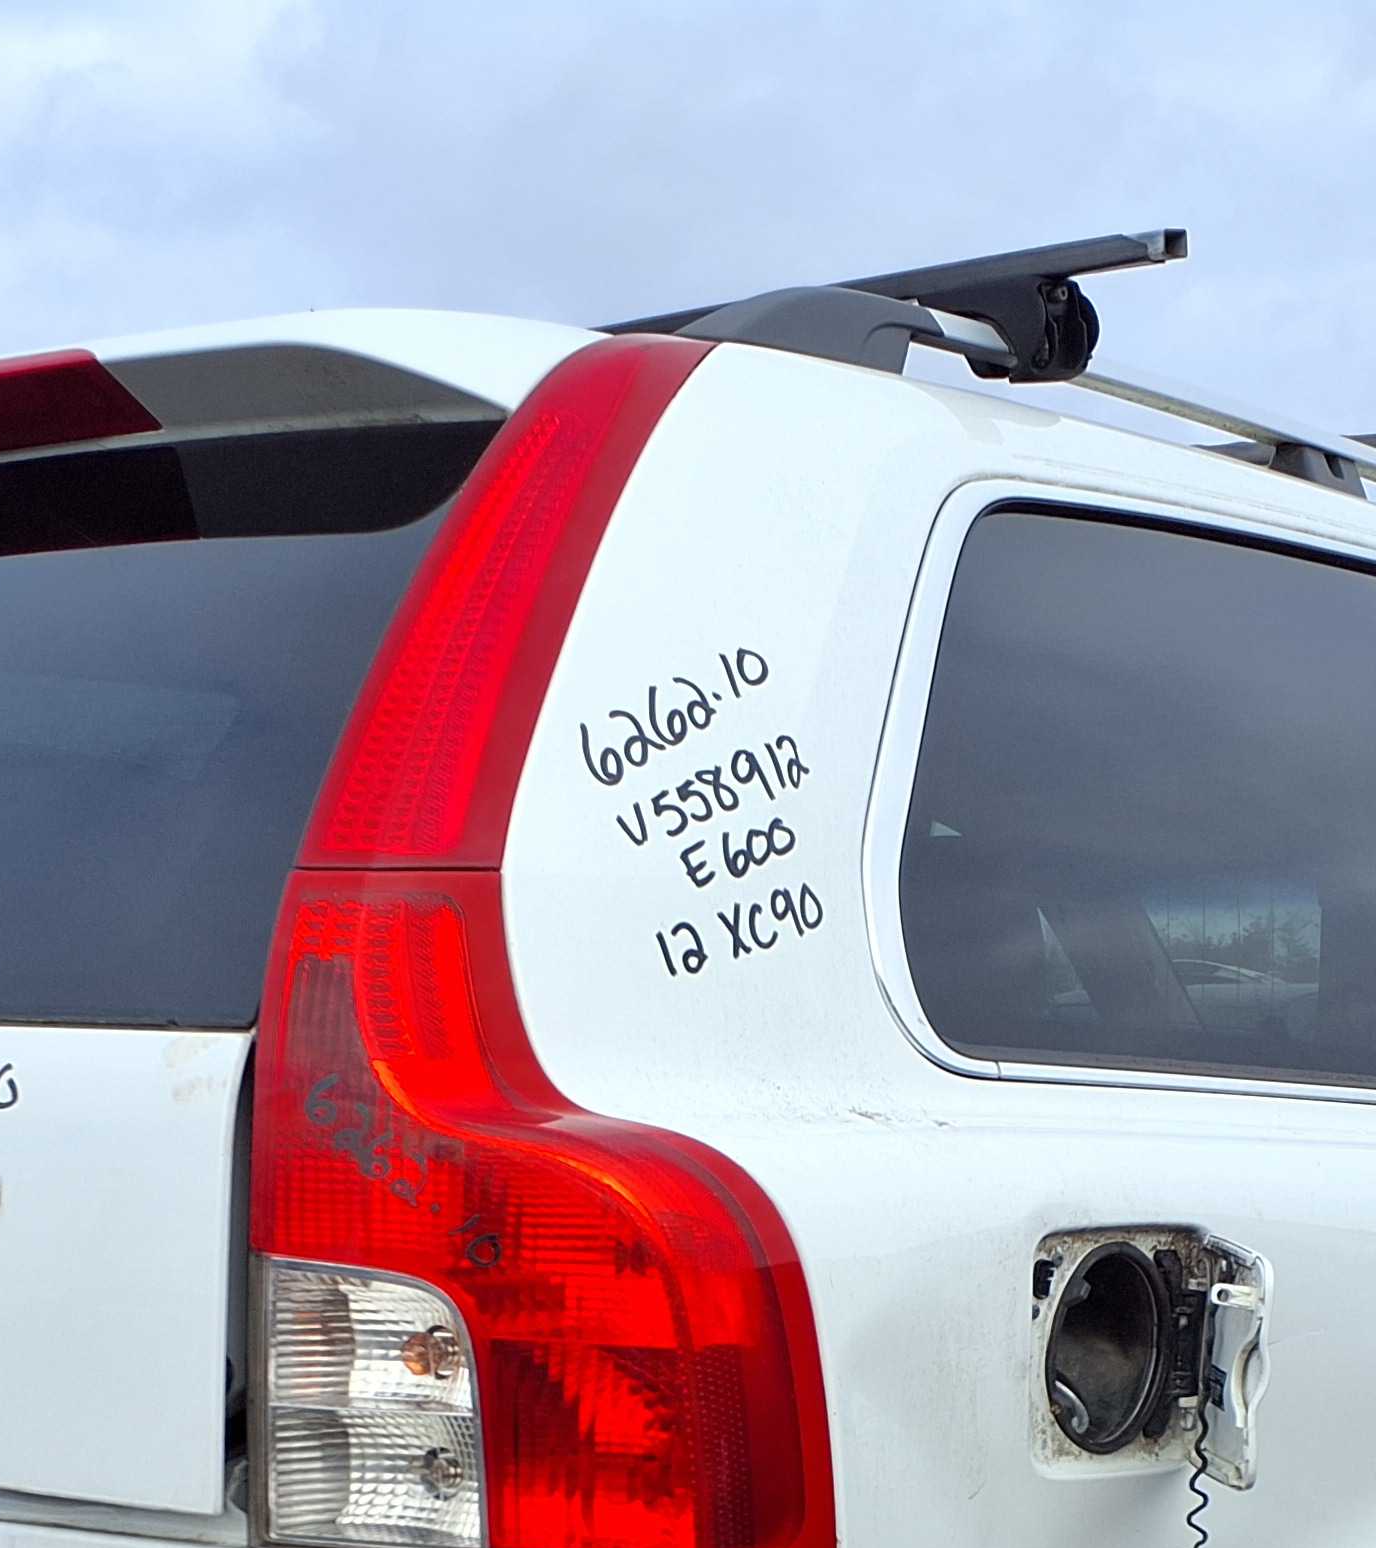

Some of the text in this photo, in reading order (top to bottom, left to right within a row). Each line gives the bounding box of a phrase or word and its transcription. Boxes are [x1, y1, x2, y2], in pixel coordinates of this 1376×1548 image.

[616, 735, 810, 846] V558912
[680, 817, 796, 887] E600
[655, 883, 823, 977] 12 XC90
